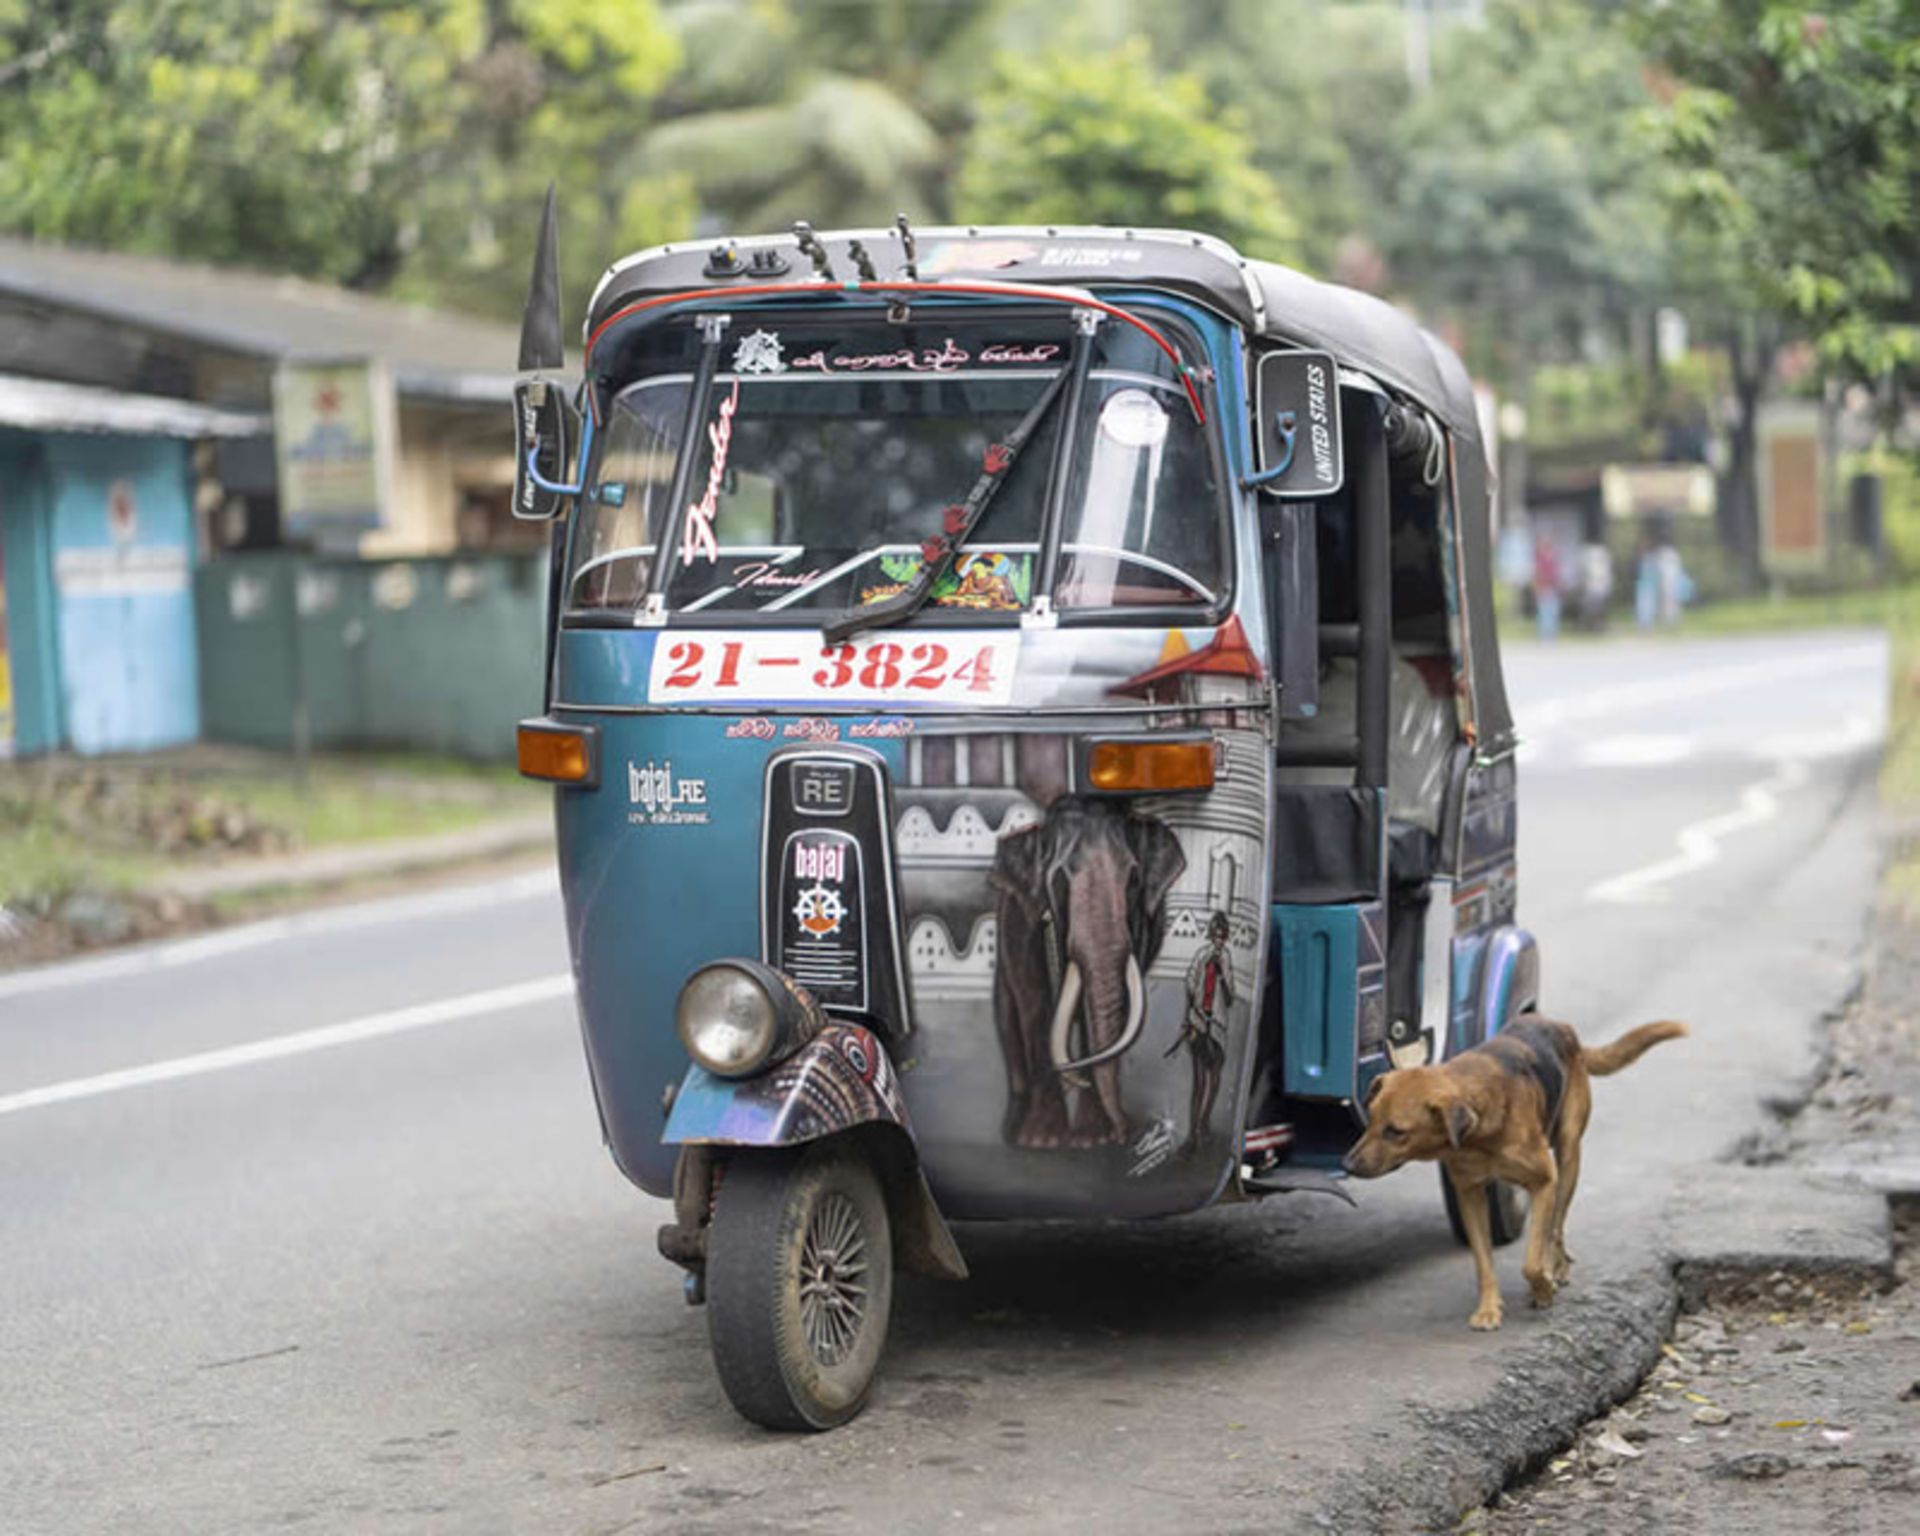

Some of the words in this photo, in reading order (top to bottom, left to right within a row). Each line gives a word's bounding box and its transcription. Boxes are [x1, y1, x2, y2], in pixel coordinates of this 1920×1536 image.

[1307, 363, 1328, 424] STATES
[683, 376, 741, 567] Fender
[1312, 424, 1334, 483] UNITED
[802, 779, 843, 803] RE
[794, 842, 846, 883] bajaj
